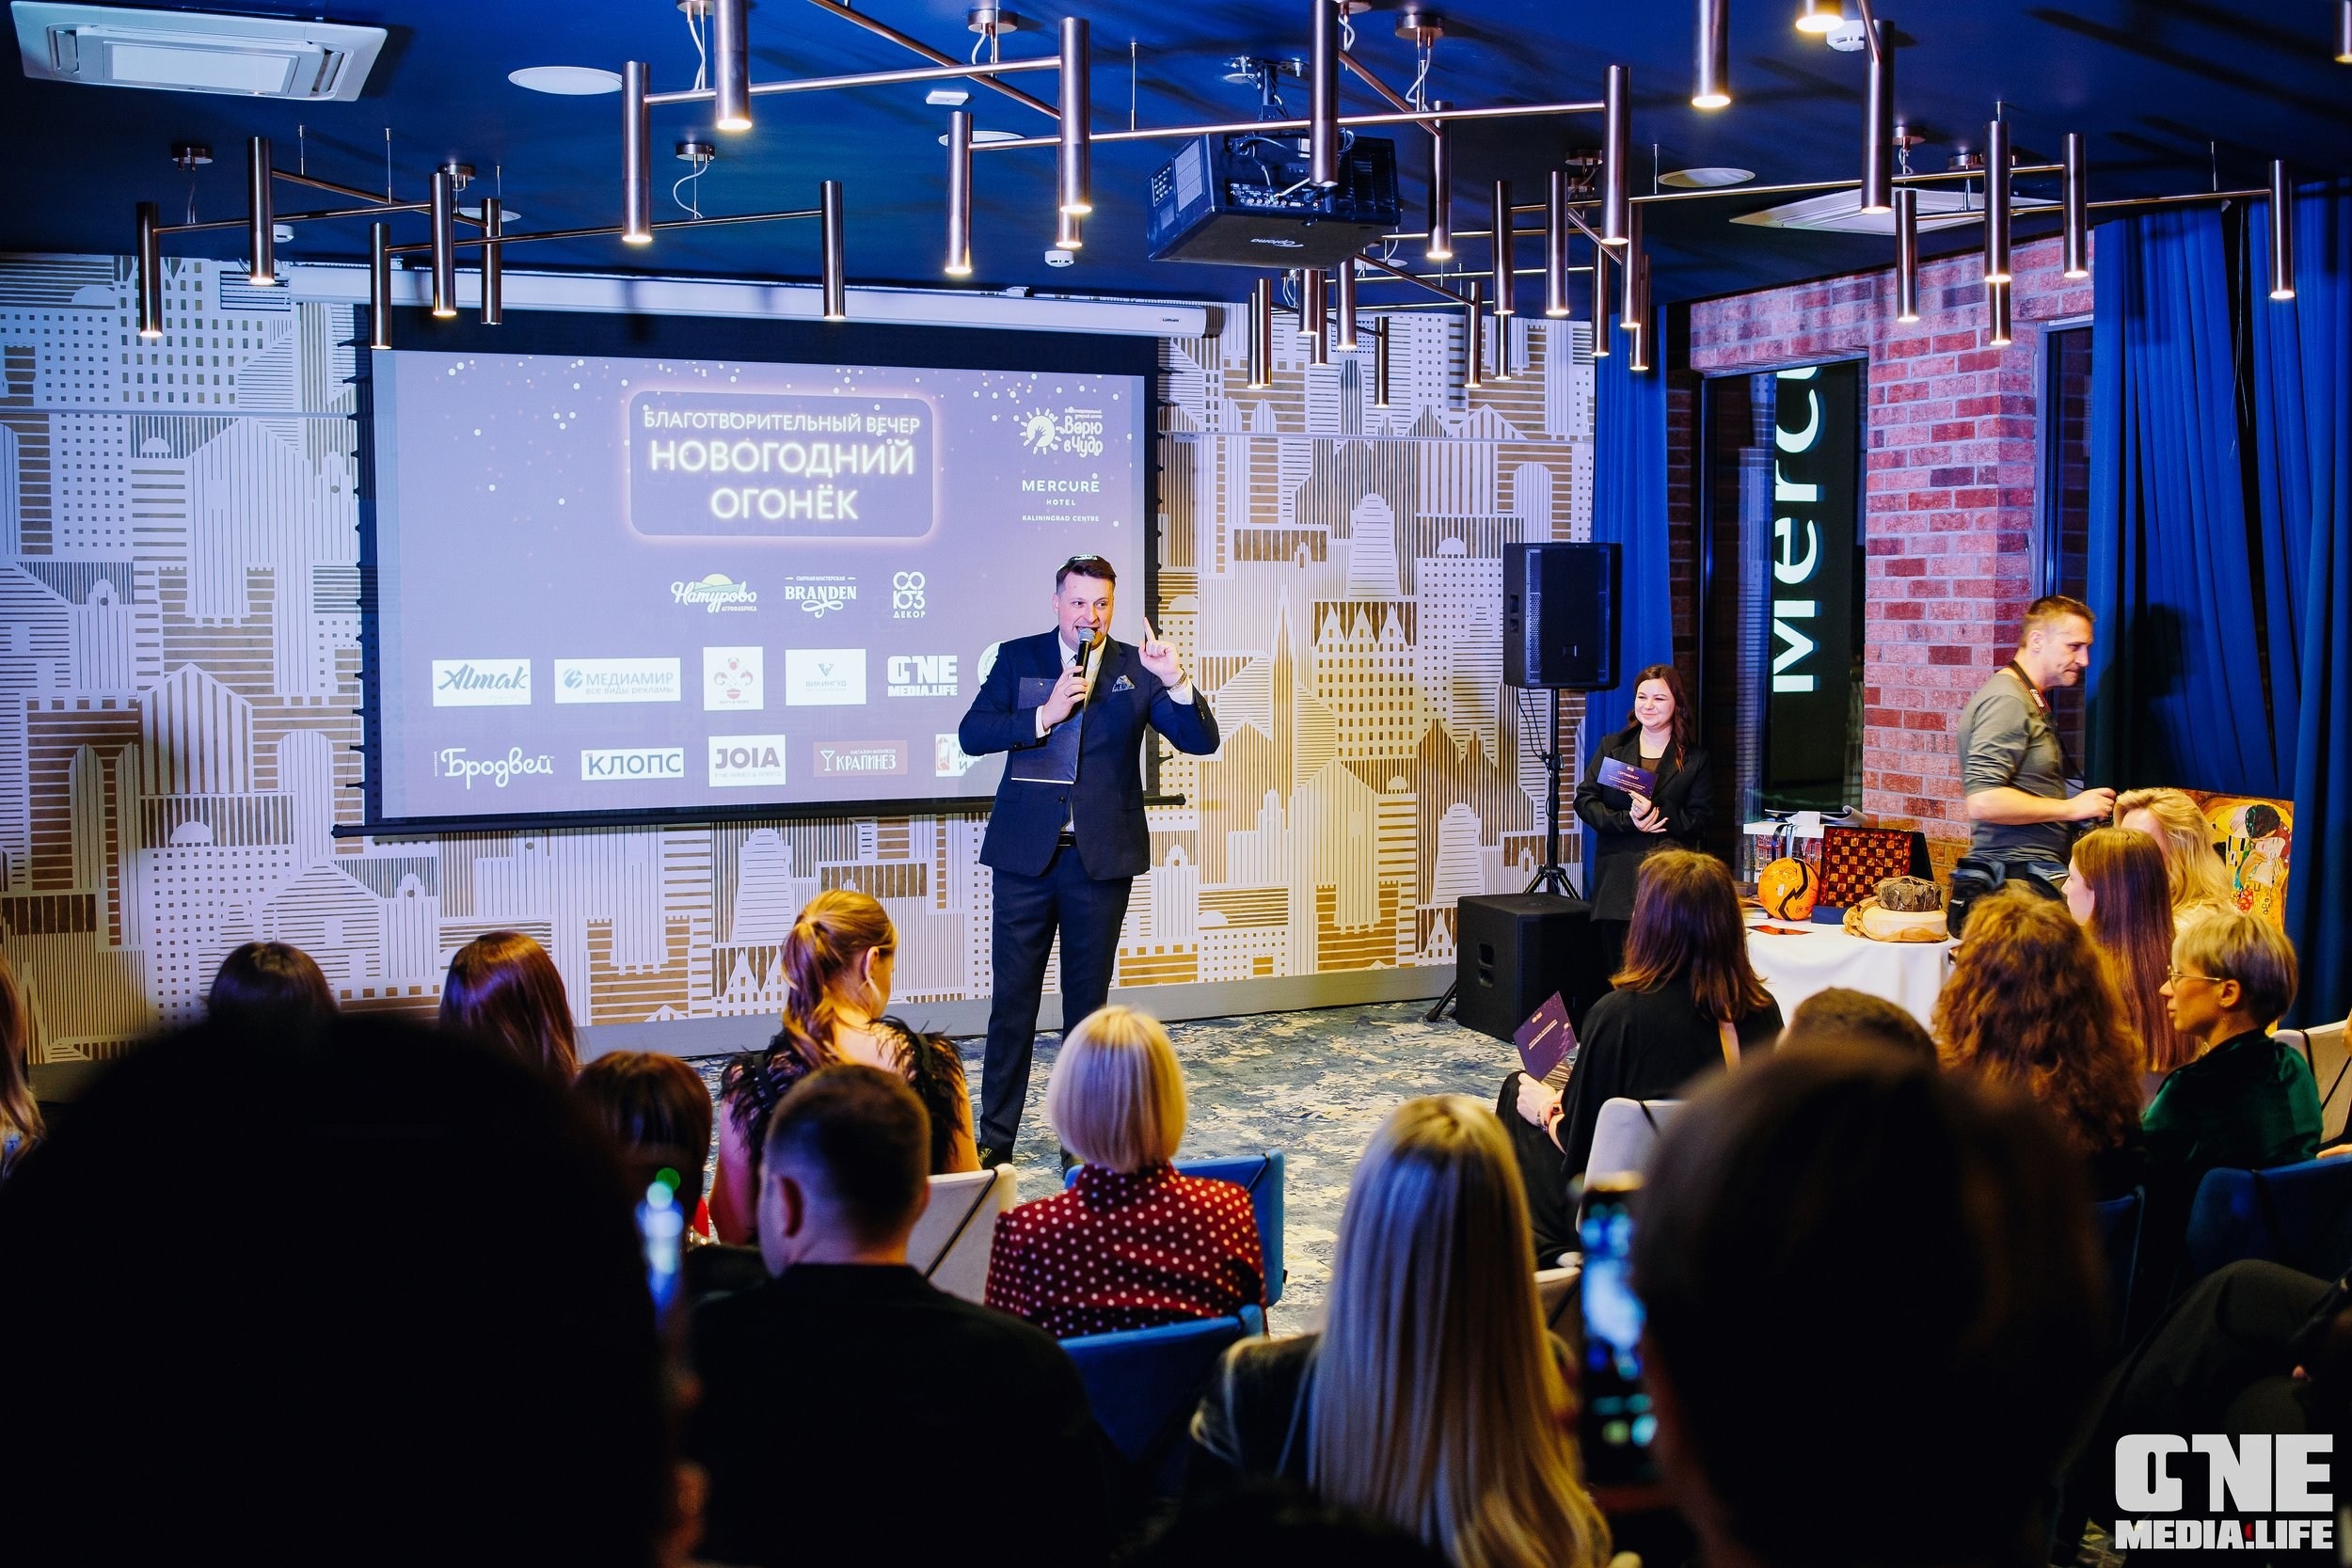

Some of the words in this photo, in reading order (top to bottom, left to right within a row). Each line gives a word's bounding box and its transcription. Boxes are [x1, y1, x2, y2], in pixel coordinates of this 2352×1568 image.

[644, 411, 862, 433] БЛАГОТВОРИТЕЛЬНЫЙ
[866, 417, 920, 434] ВЕЧЕР
[651, 439, 914, 478] НОВОГОДНИЙ
[1022, 480, 1100, 493] MERCURE
[710, 484, 858, 519] ОГОНЁК
[1772, 366, 1820, 692] Merc
[671, 580, 757, 613] Натурово
[785, 586, 857, 601] BRANDEN
[894, 610, 926, 619] ДЕКОР
[437, 663, 529, 690] Almak
[586, 672, 674, 688] МЕДИАМИР
[604, 687, 628, 695] виды
[631, 687, 674, 695] рекламы
[887, 685, 958, 697] MEDIA.LIFE
[588, 753, 681, 775] КЛОПС
[715, 747, 781, 768] JOIA
[835, 754, 897, 771] КРАПИНЕЗ
[440, 747, 553, 790] Бродвей
